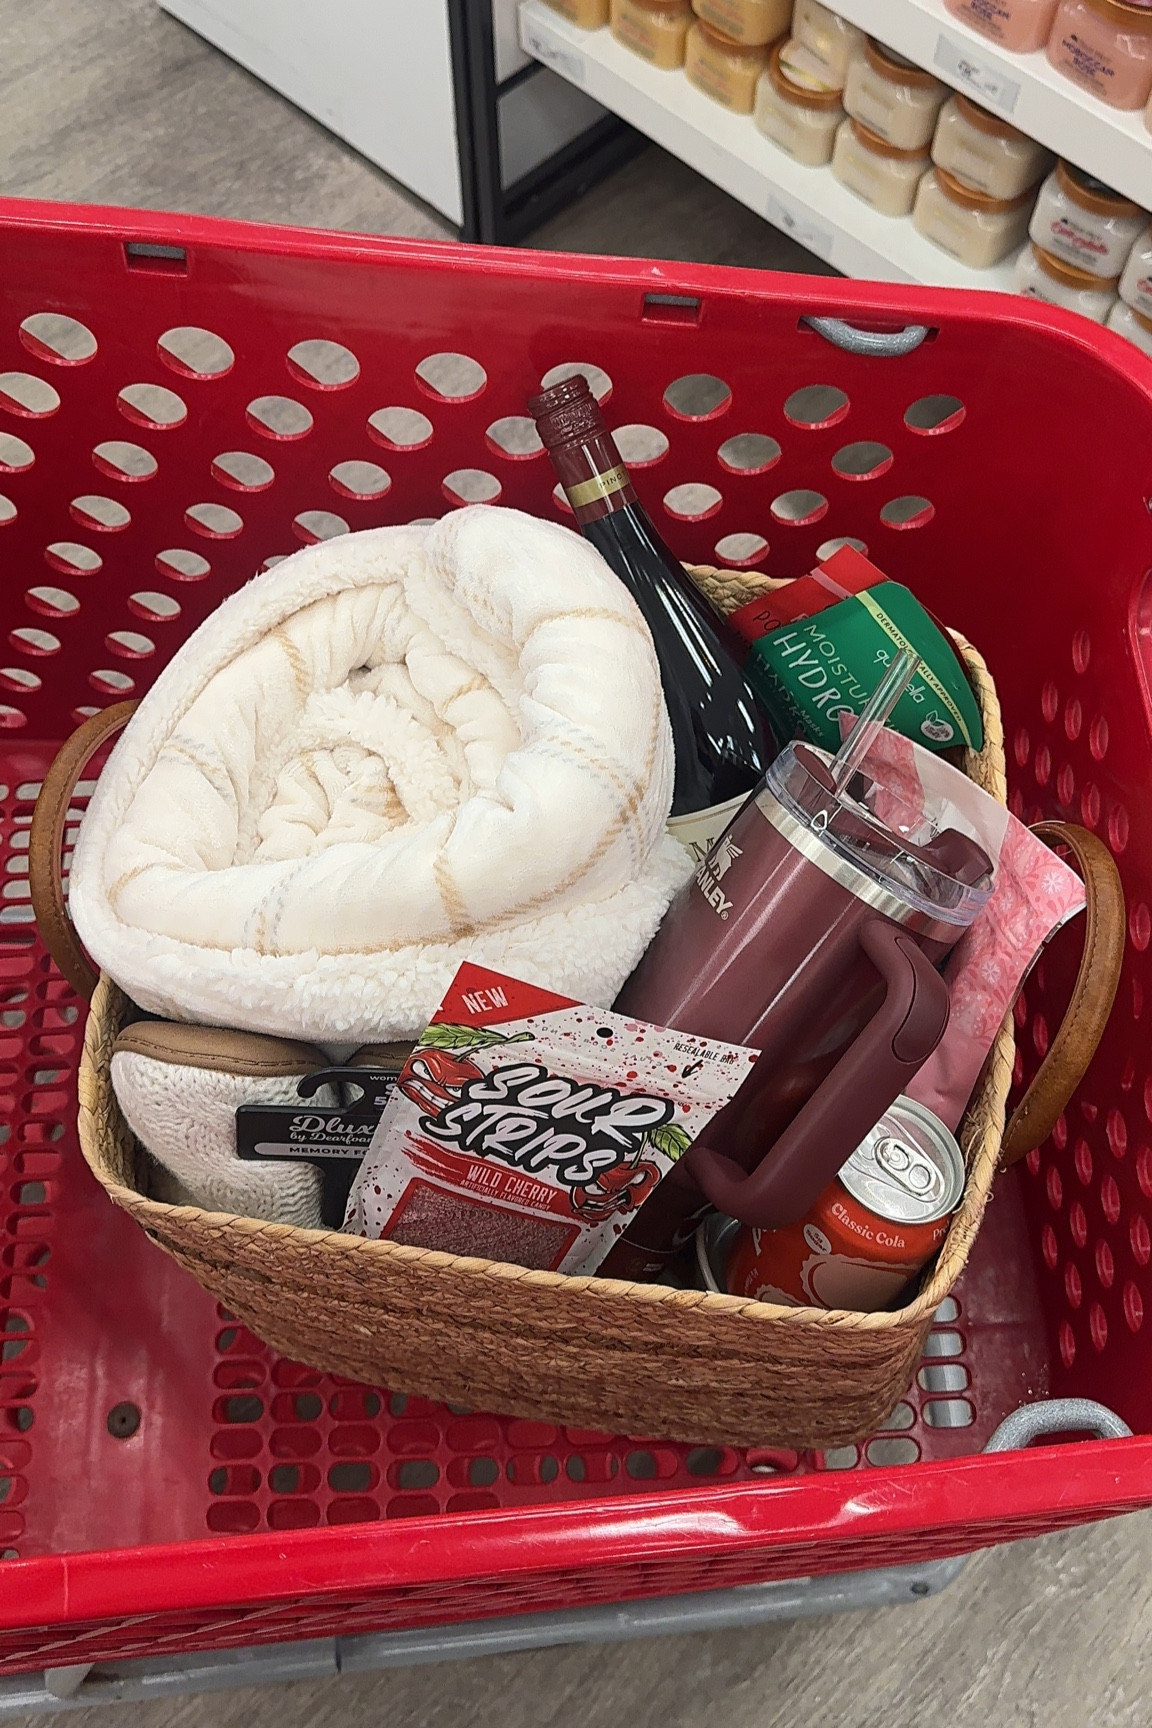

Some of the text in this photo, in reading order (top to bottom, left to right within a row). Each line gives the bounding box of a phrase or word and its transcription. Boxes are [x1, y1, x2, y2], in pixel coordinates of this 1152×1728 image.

[904, 683, 926, 704] ella
[933, 682, 962, 722] APPROVED
[800, 710, 824, 737] Masks
[696, 865, 734, 914] ANLEY
[462, 986, 509, 1014] NEW
[673, 1043, 735, 1065] RESEALABLE BAG
[469, 1066, 666, 1148] SOUR
[289, 1115, 376, 1135] Dlux
[290, 1131, 307, 1142] by
[289, 1147, 349, 1155] MEMORY
[425, 1102, 617, 1181] STRIPS
[460, 1179, 552, 1211] ARTIFICIALLY FLAVORED CANDY
[466, 1164, 558, 1204] WILD CHERRY
[831, 1201, 906, 1249] Classic Cola
